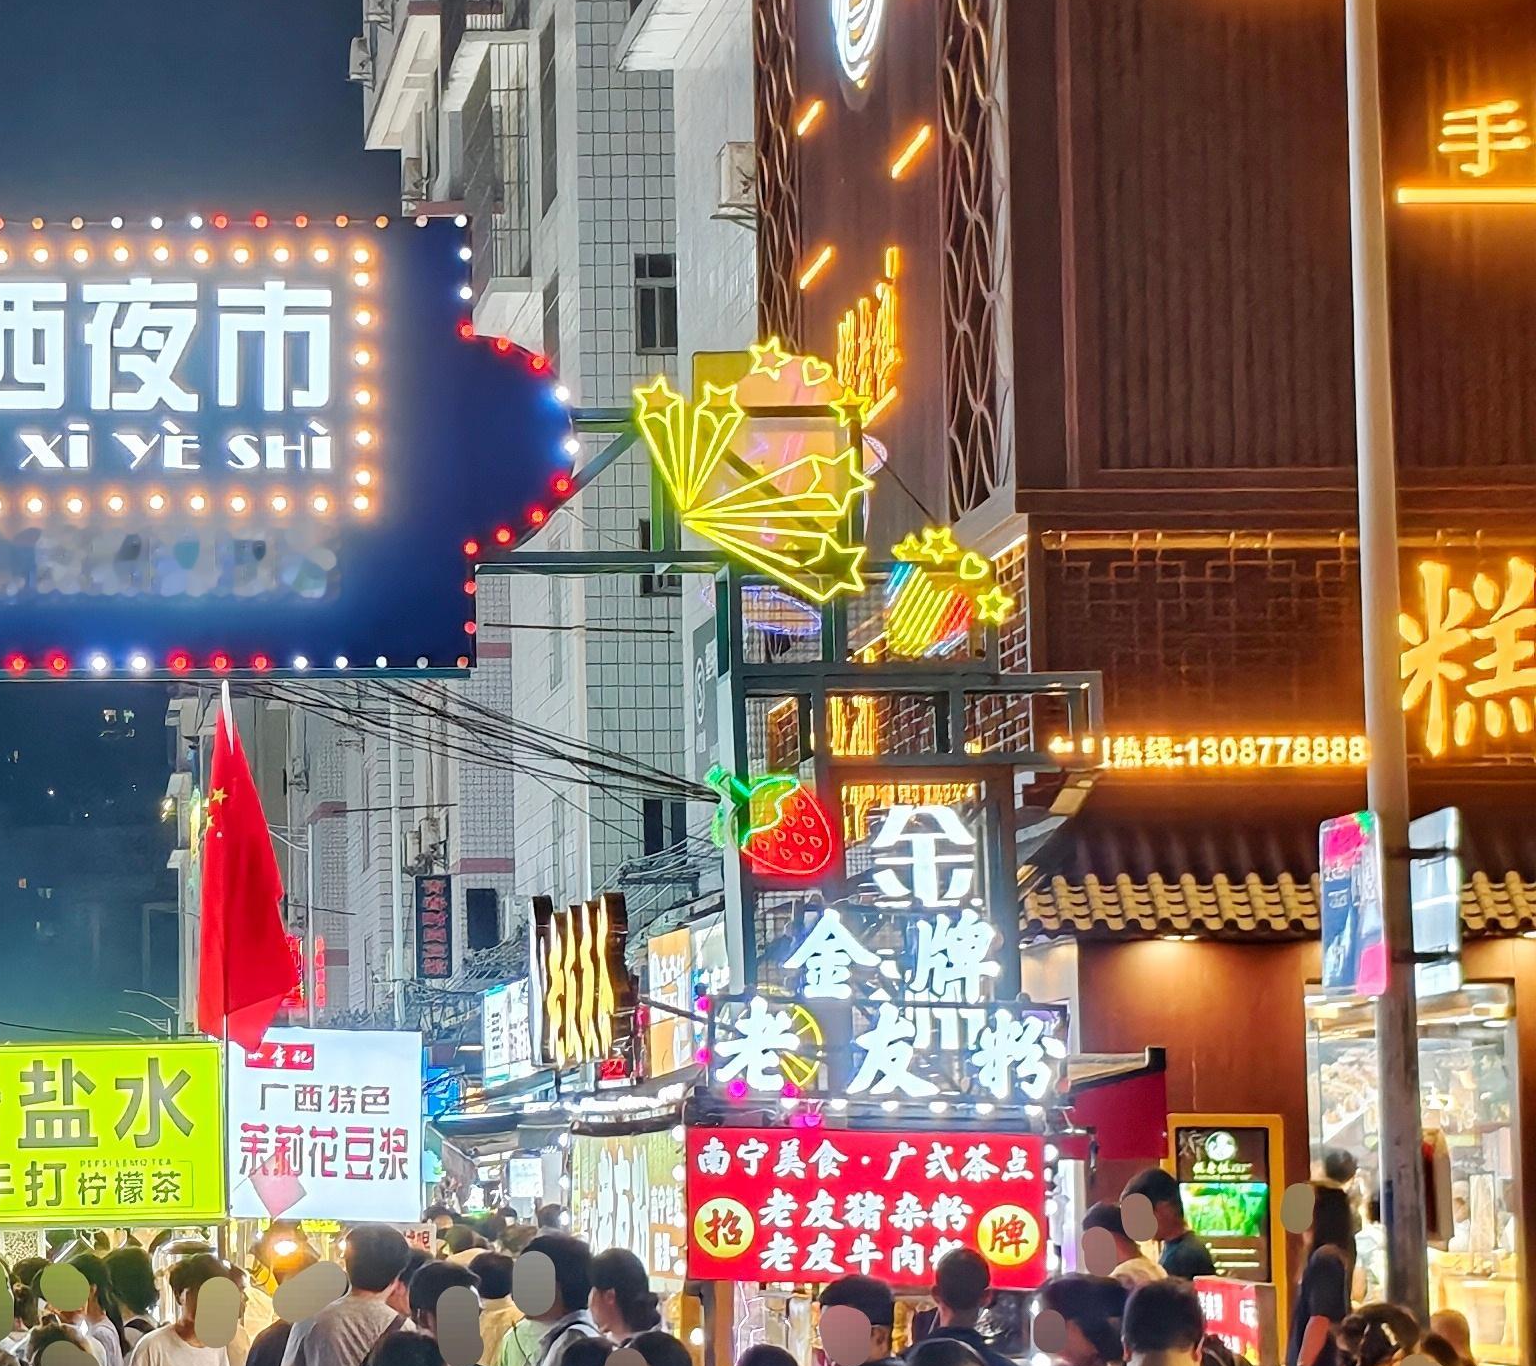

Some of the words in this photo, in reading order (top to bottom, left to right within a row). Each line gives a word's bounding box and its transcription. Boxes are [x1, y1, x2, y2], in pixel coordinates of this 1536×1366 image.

[227, 420, 332, 470] SHÌ
[1398, 556, 1536, 758] 糕
[783, 908, 1002, 1004] 金牌
[715, 996, 1068, 1101] 老友粉
[260, 1083, 390, 1115] 广西特色
[239, 1122, 409, 1181] 茉莉花豆浆
[696, 1137, 1035, 1183] 南宁美食·广式茶点
[703, 1208, 744, 1249] 招
[758, 1187, 974, 1232] 老友猪杂粉
[990, 1214, 1030, 1259] 牌
